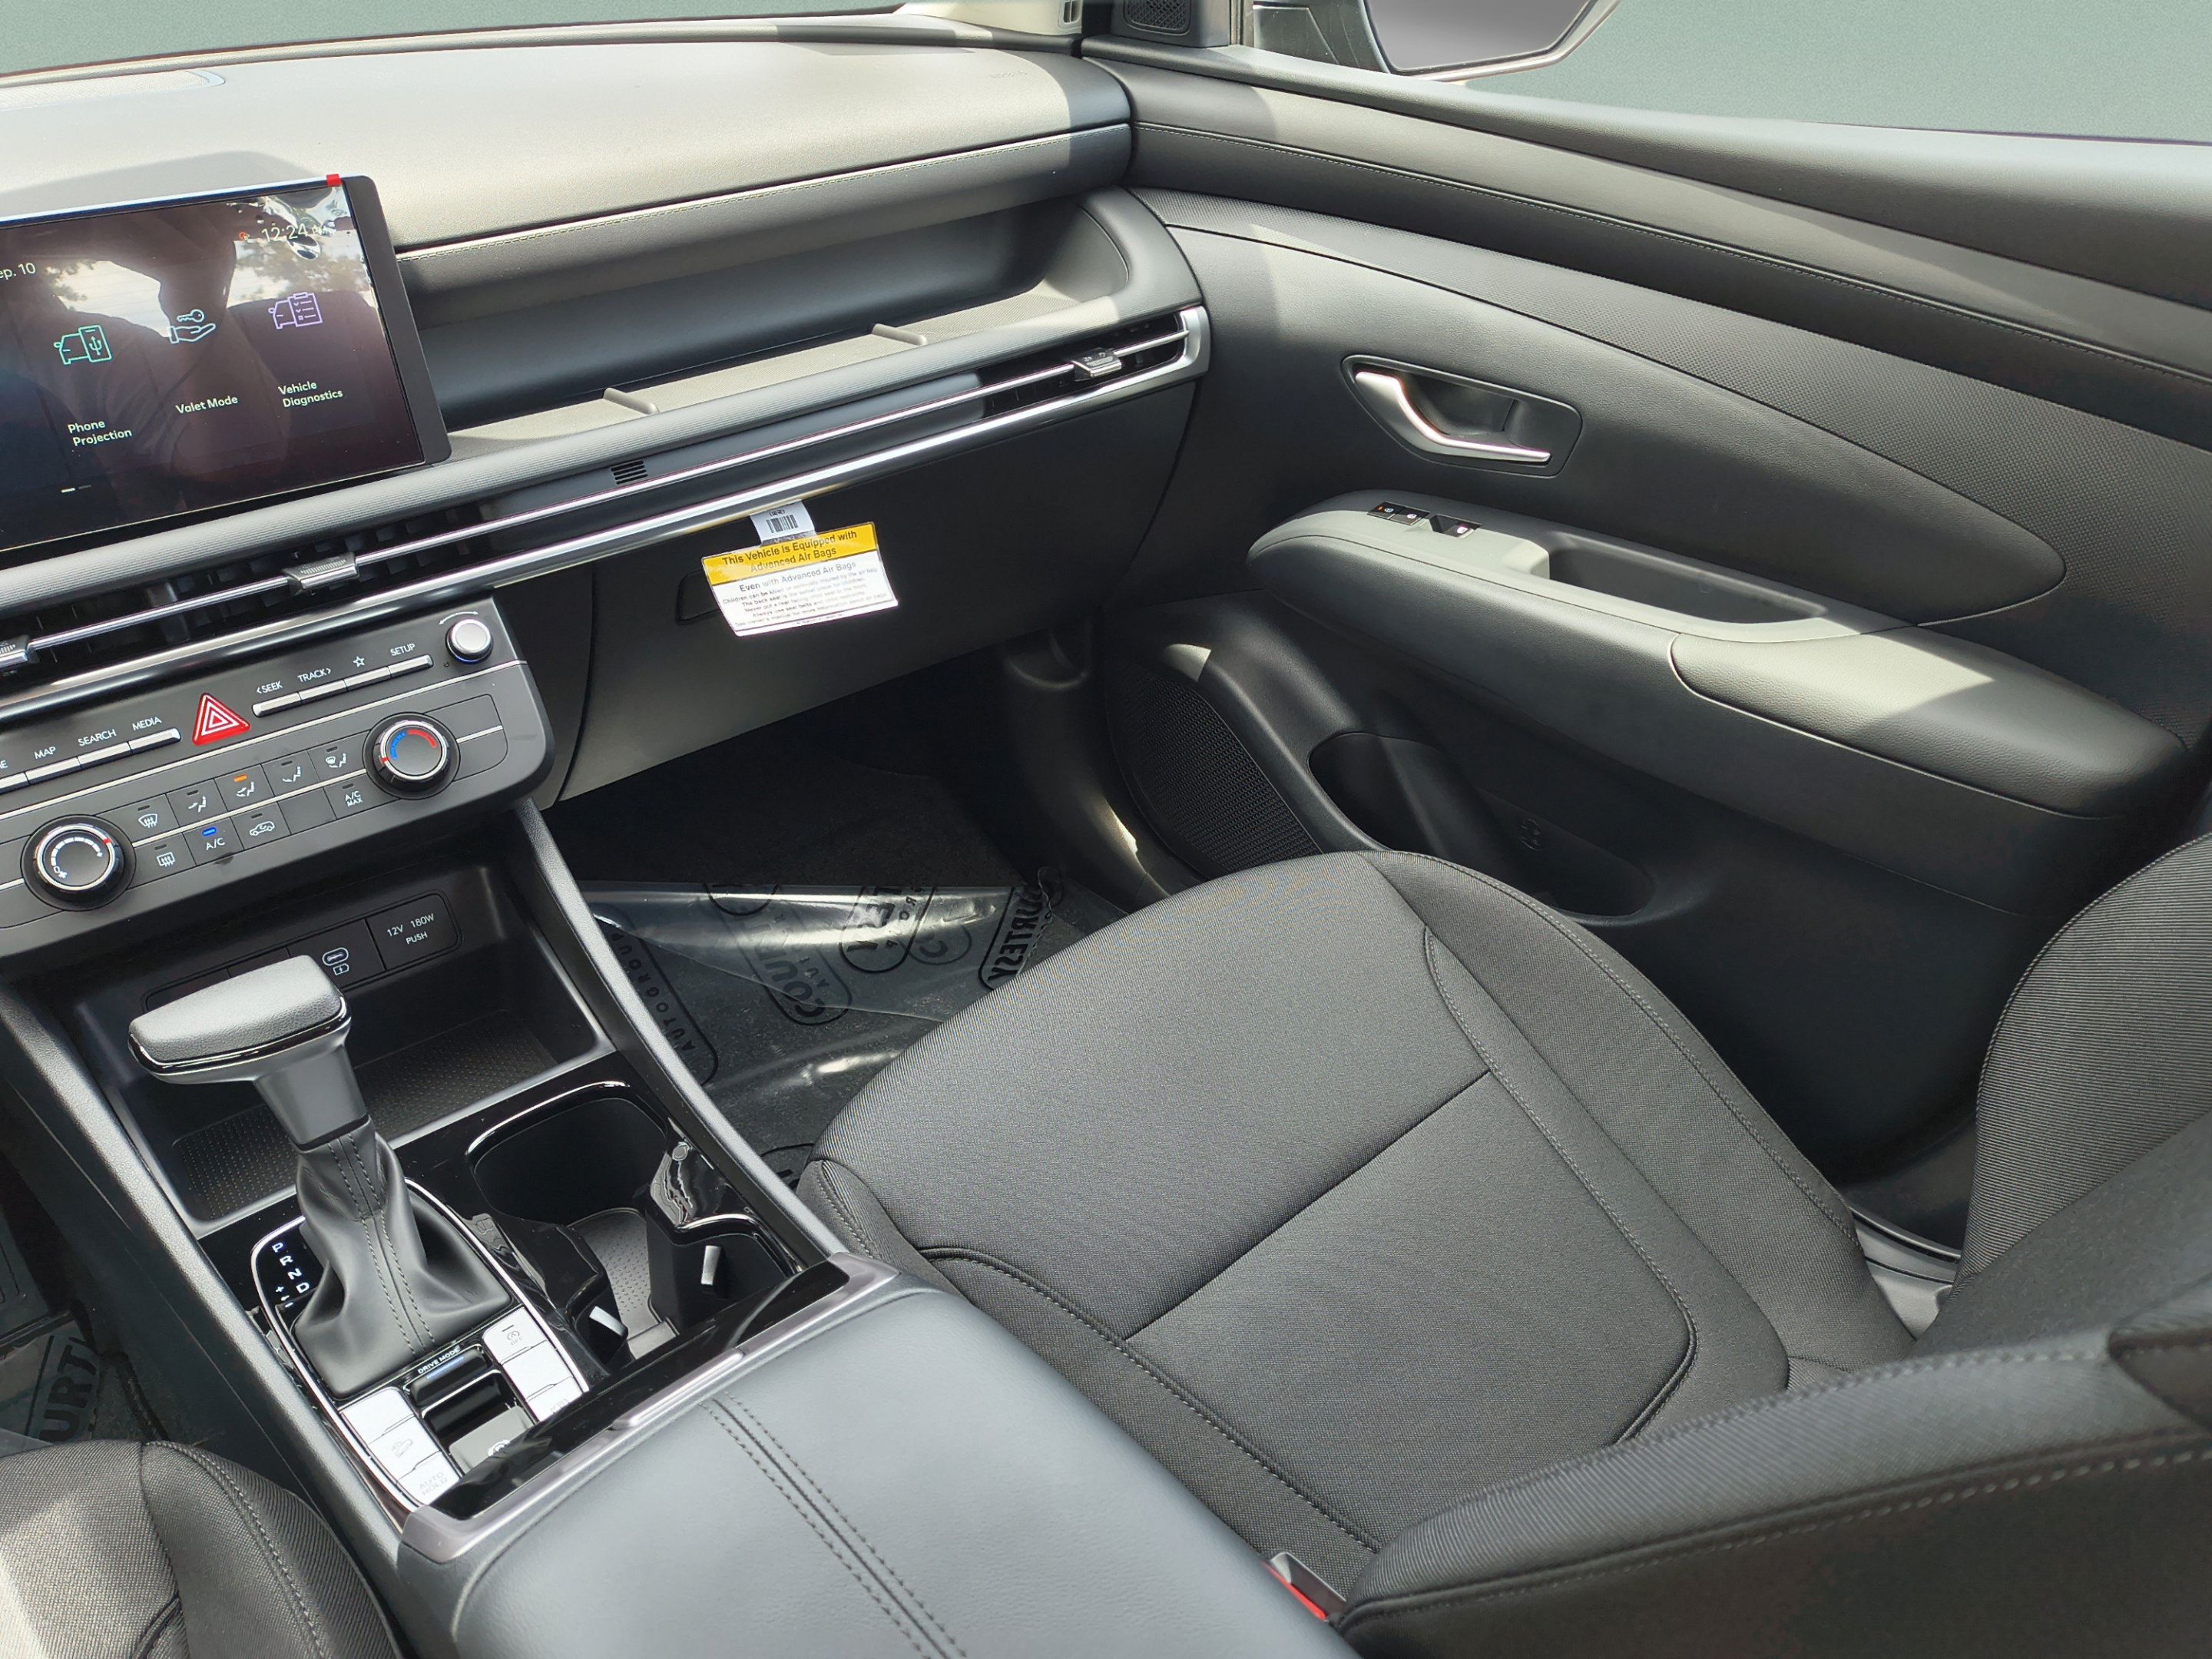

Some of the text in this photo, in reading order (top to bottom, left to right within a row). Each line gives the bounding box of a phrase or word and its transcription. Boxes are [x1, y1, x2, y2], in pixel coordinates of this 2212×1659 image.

[262, 223, 308, 242] 12:24
[0, 262, 36, 280] ep. 10
[278, 380, 317, 396] Vehicle
[175, 396, 239, 414] Valet Mode
[283, 389, 343, 408] Diagnostics
[68, 420, 106, 434] Phone
[72, 429, 133, 447] Projection
[723, 555, 743, 565] This
[745, 548, 780, 561] Vehicle
[792, 535, 836, 551] Equipped
[837, 529, 857, 541] with
[750, 547, 837, 572] Advanced Air Bags
[739, 582, 760, 592] Even
[762, 578, 780, 587] with
[781, 570, 821, 582] Advanced
[836, 561, 857, 571] Bags
[390, 643, 416, 656] SETUP
[132, 717, 162, 730] MEDIA
[78, 729, 117, 747] SEARCH
[34, 746, 56, 759] MAP
[345, 790, 361, 802] A/C
[347, 796, 363, 806] MAX
[206, 837, 226, 850] A/C
[386, 913, 434, 937] 12V 180W
[406, 931, 428, 945] PUSH
[272, 1242, 284, 1253] P
[280, 1255, 293, 1266] R
[288, 1268, 303, 1280] N
[296, 1282, 310, 1293] D
[417, 1346, 462, 1374] DRIVE MODE
[419, 1472, 445, 1490] AUTO
[422, 1476, 449, 1497] HOLD
